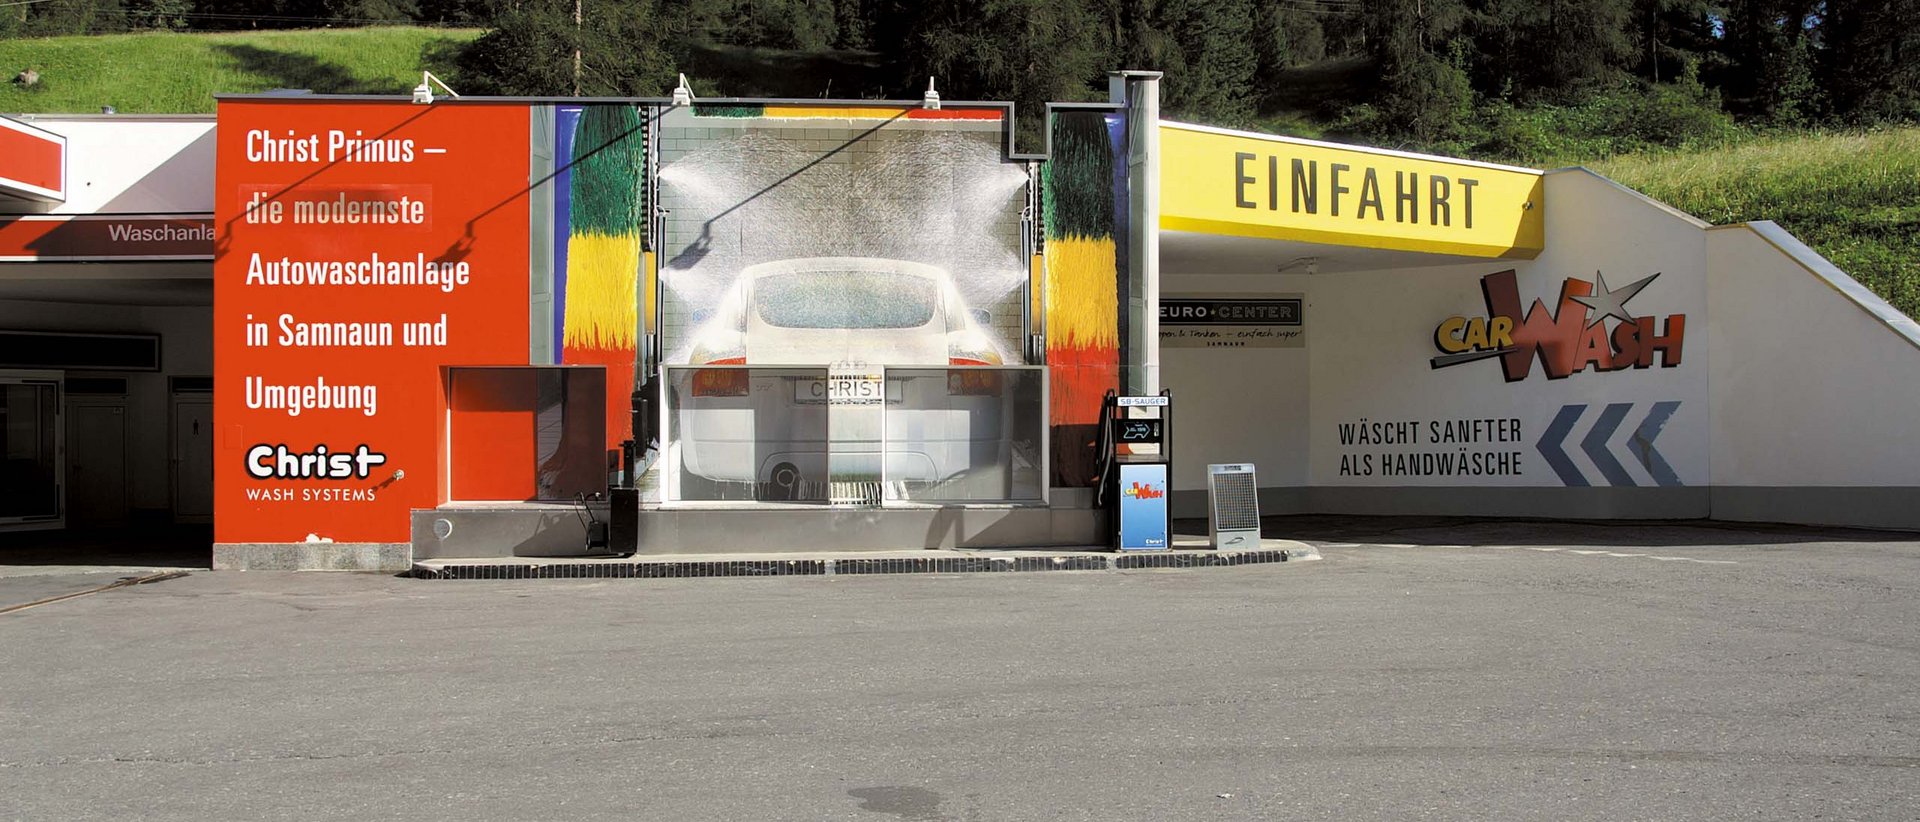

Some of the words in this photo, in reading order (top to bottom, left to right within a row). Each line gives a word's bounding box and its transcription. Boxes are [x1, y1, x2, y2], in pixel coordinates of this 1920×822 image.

[246, 129, 319, 163] Christ
[328, 129, 415, 163] Primus
[1235, 151, 1479, 229] EINFAHRT
[246, 192, 283, 224] die
[294, 192, 424, 224] modernste
[246, 252, 470, 293] Autowaschanlage
[1159, 306, 1207, 318] EURO
[1218, 306, 1292, 318] CENTER
[1434, 316, 1514, 353] CAR
[1480, 268, 1686, 383] WASH
[246, 314, 268, 346] in
[278, 313, 393, 346] Samnaun
[403, 313, 447, 346] und
[245, 376, 377, 416] Umgebung
[811, 381, 883, 397] CHRIST
[1338, 418, 1420, 445] WÄSCHT
[1430, 419, 1522, 443] SANFTER
[246, 444, 386, 479] Christ
[1339, 454, 1373, 476] ALS
[1382, 447, 1522, 476] HANDWÄSCHE
[246, 488, 294, 501] WASH
[302, 488, 376, 501] SYSTEMS
